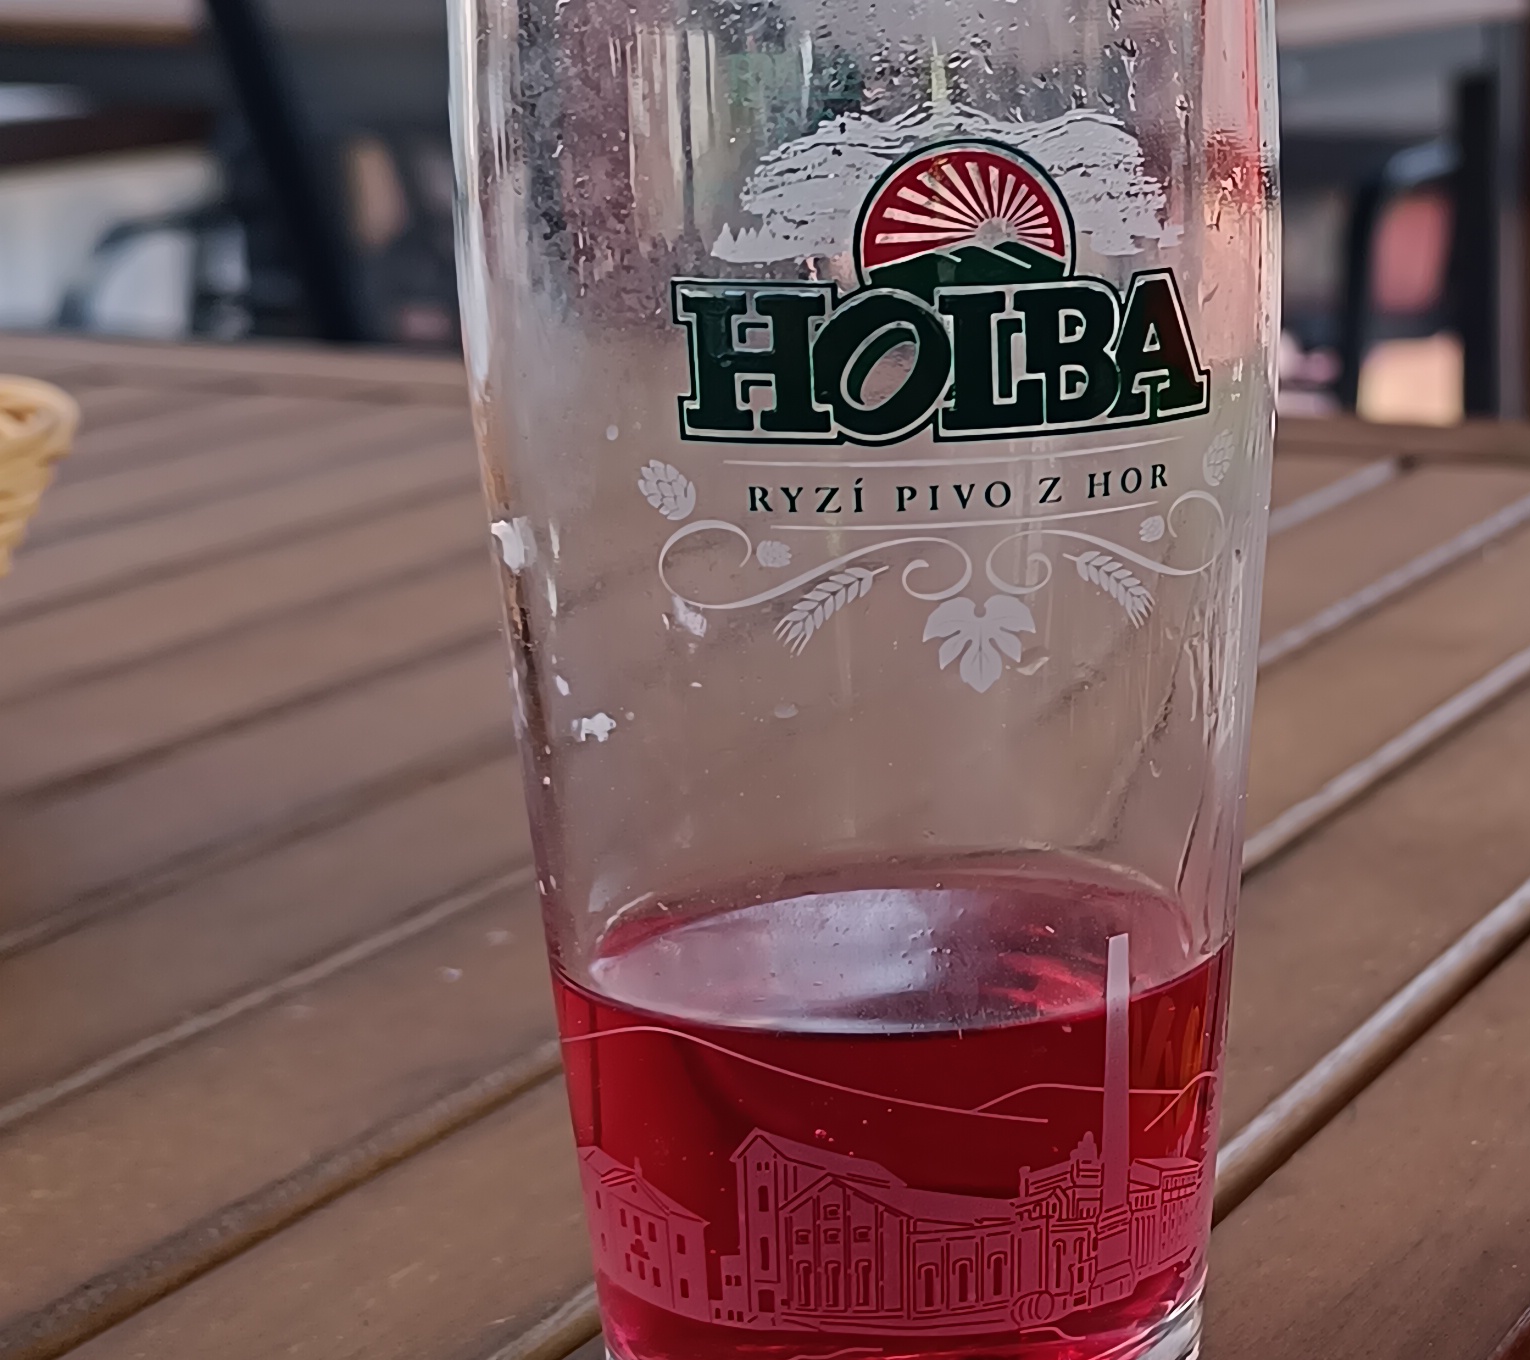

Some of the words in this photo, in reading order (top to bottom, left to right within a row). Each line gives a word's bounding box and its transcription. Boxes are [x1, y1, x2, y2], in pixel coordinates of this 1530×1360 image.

[671, 266, 1211, 447] HOLBA
[748, 477, 865, 514] RYZÍ
[895, 480, 1012, 514] PIVO
[1037, 476, 1063, 505] Z
[1086, 462, 1169, 500] HOR
